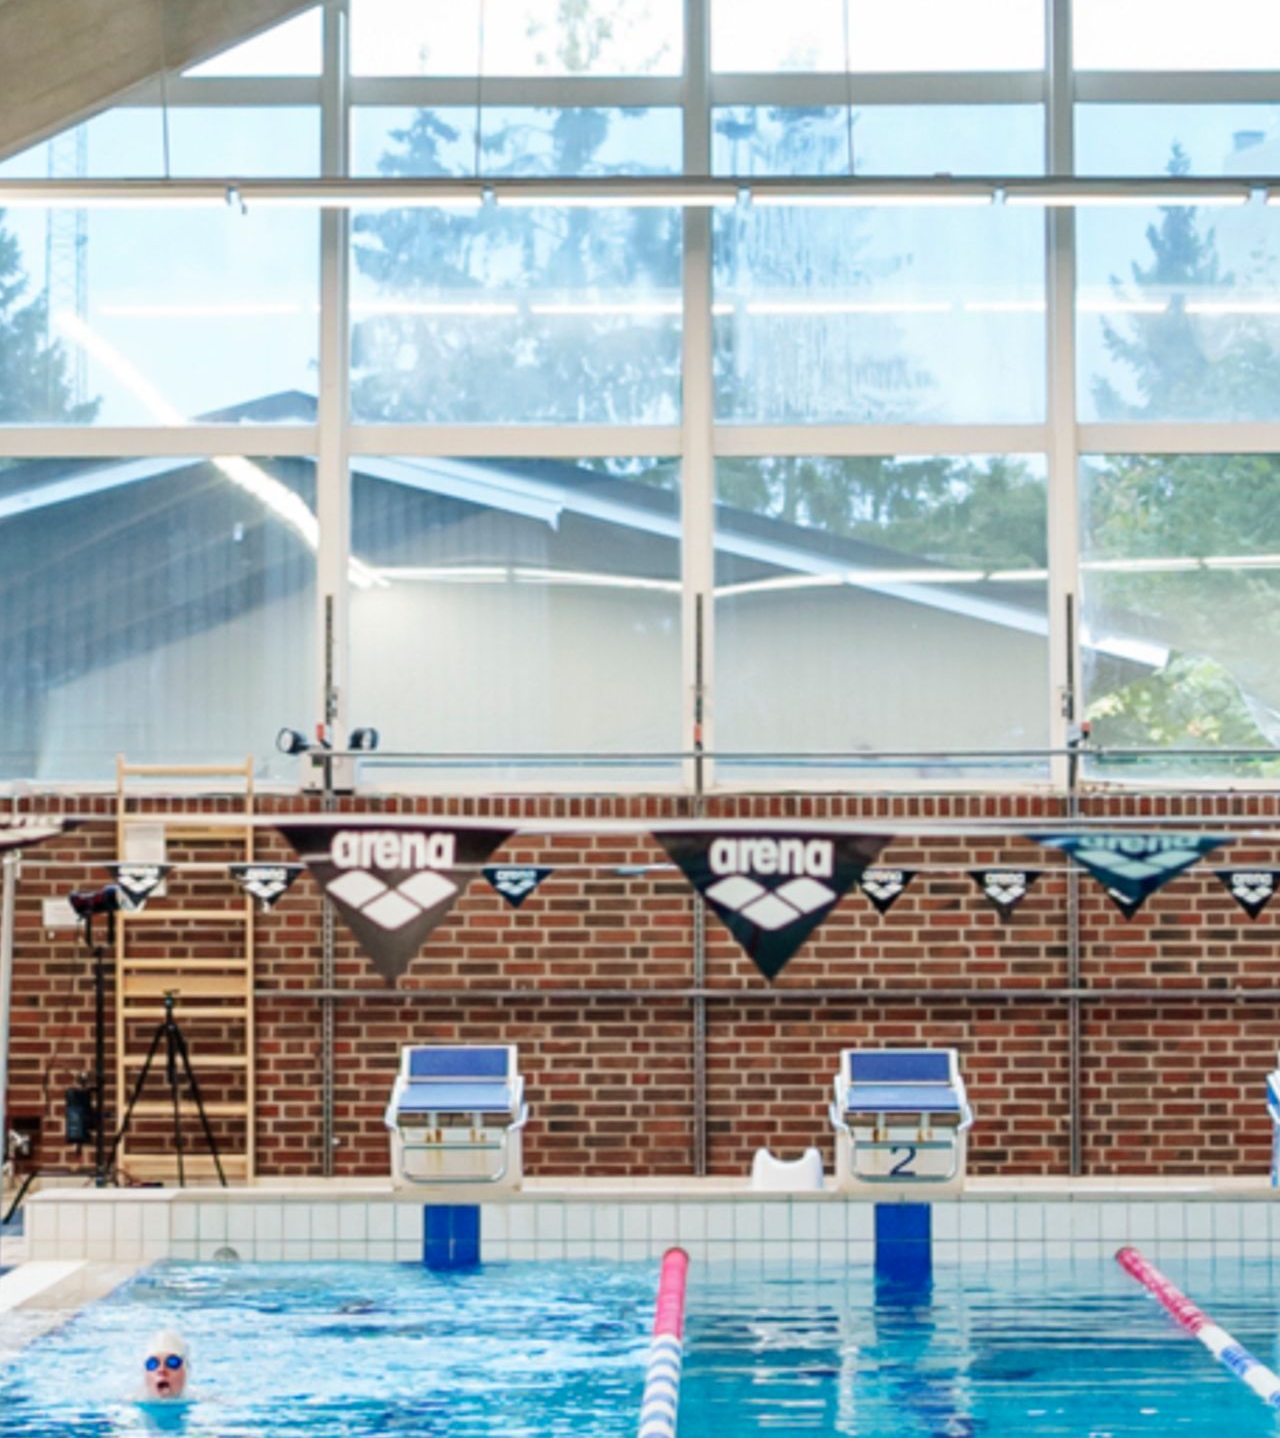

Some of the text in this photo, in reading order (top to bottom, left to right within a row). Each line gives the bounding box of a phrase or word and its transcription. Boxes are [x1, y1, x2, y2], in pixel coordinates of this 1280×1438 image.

[331, 830, 456, 869] arena
[709, 837, 834, 875] arena
[890, 1146, 917, 1177] 2
